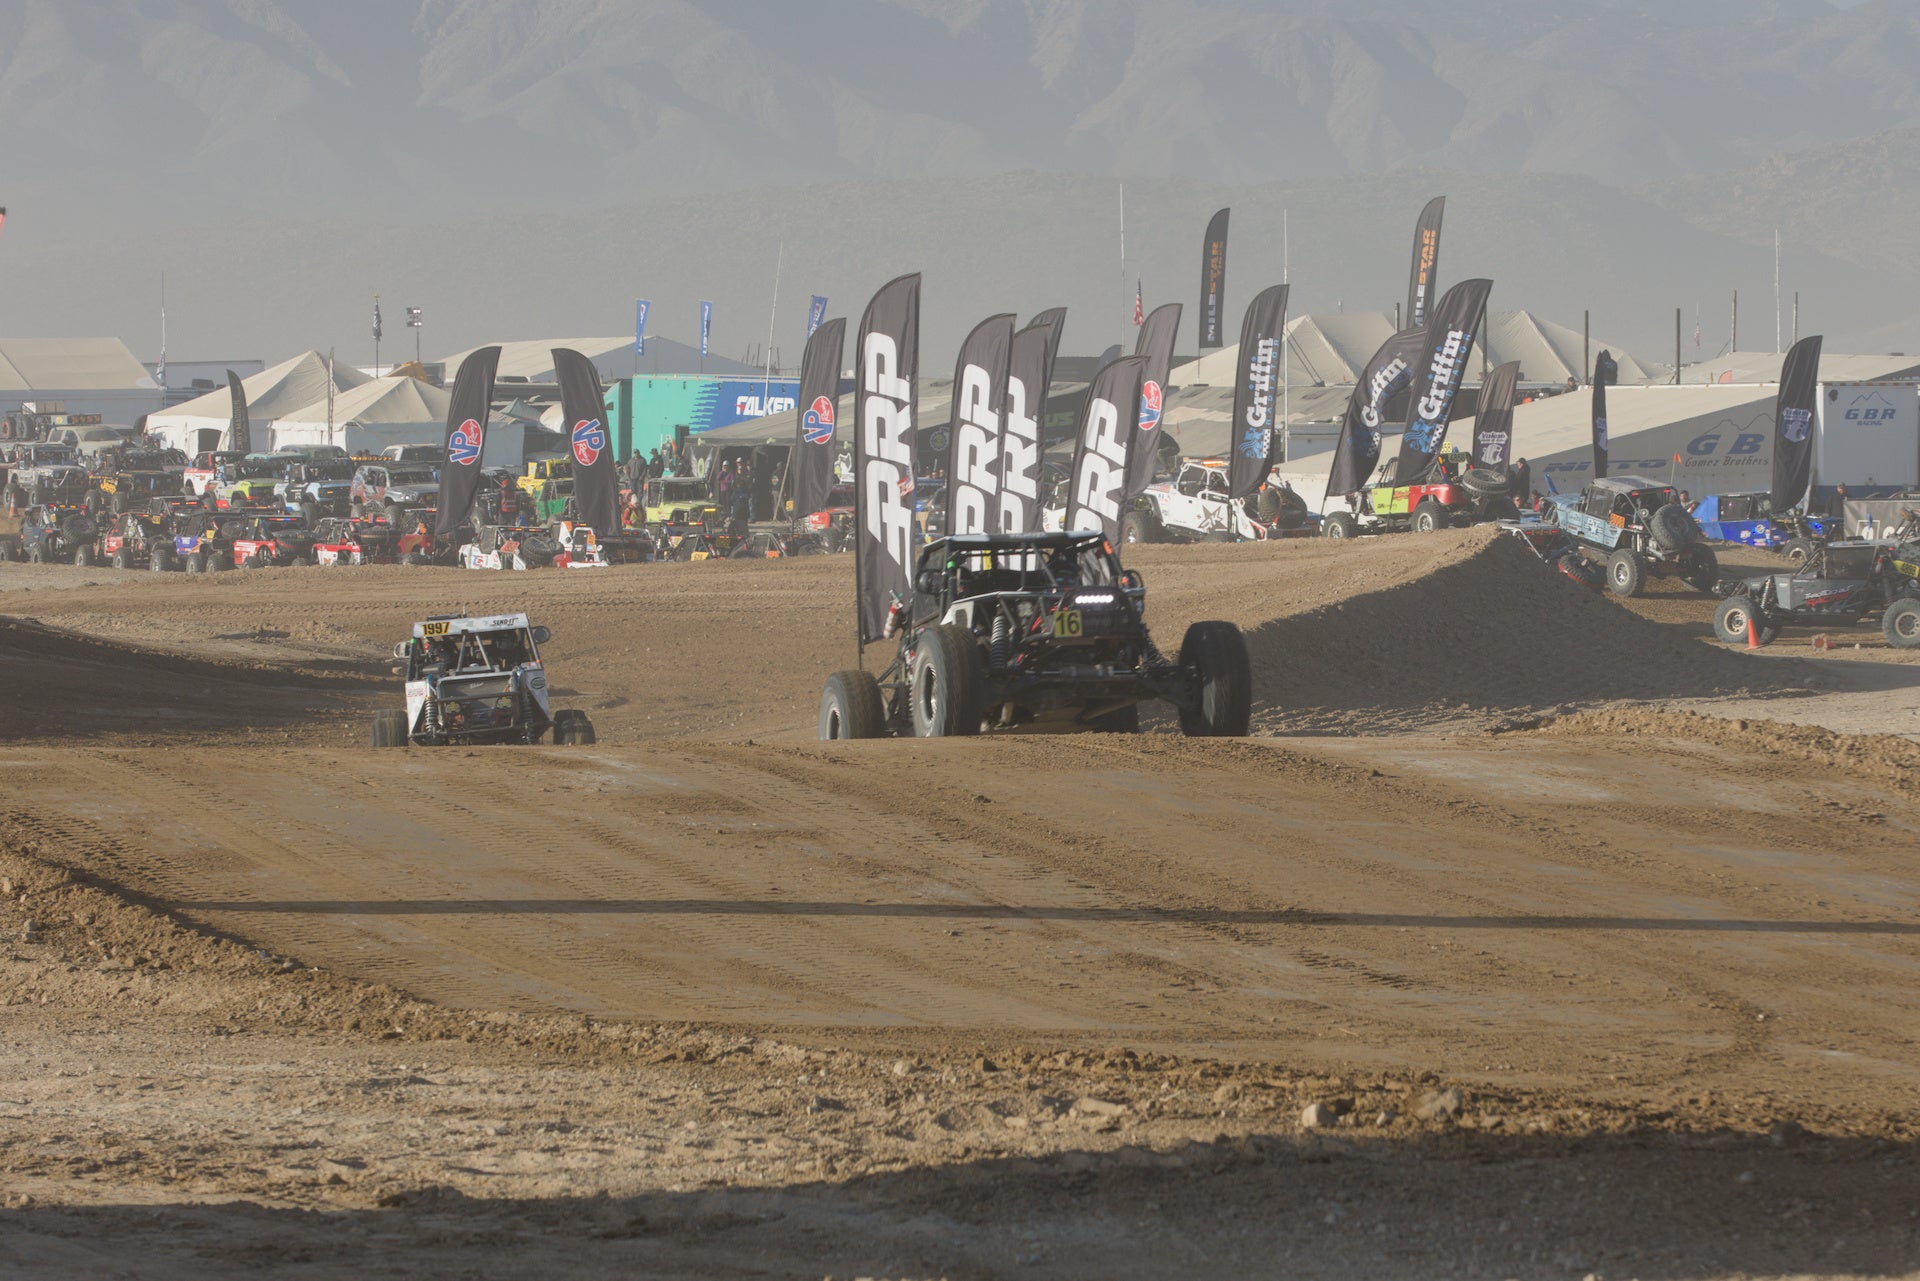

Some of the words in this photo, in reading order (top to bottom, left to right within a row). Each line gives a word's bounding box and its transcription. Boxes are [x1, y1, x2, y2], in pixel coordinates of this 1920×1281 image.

[1246, 337, 1273, 428] Griffin
[1417, 330, 1464, 420] Griffin
[735, 395, 795, 416] FALKEN
[1361, 358, 1408, 428] Griffin
[572, 419, 606, 451] VP
[803, 409, 834, 443] VP
[449, 430, 480, 463] VP
[864, 331, 911, 588] PRP
[422, 621, 450, 637] 1997
[1055, 613, 1081, 635] 16
